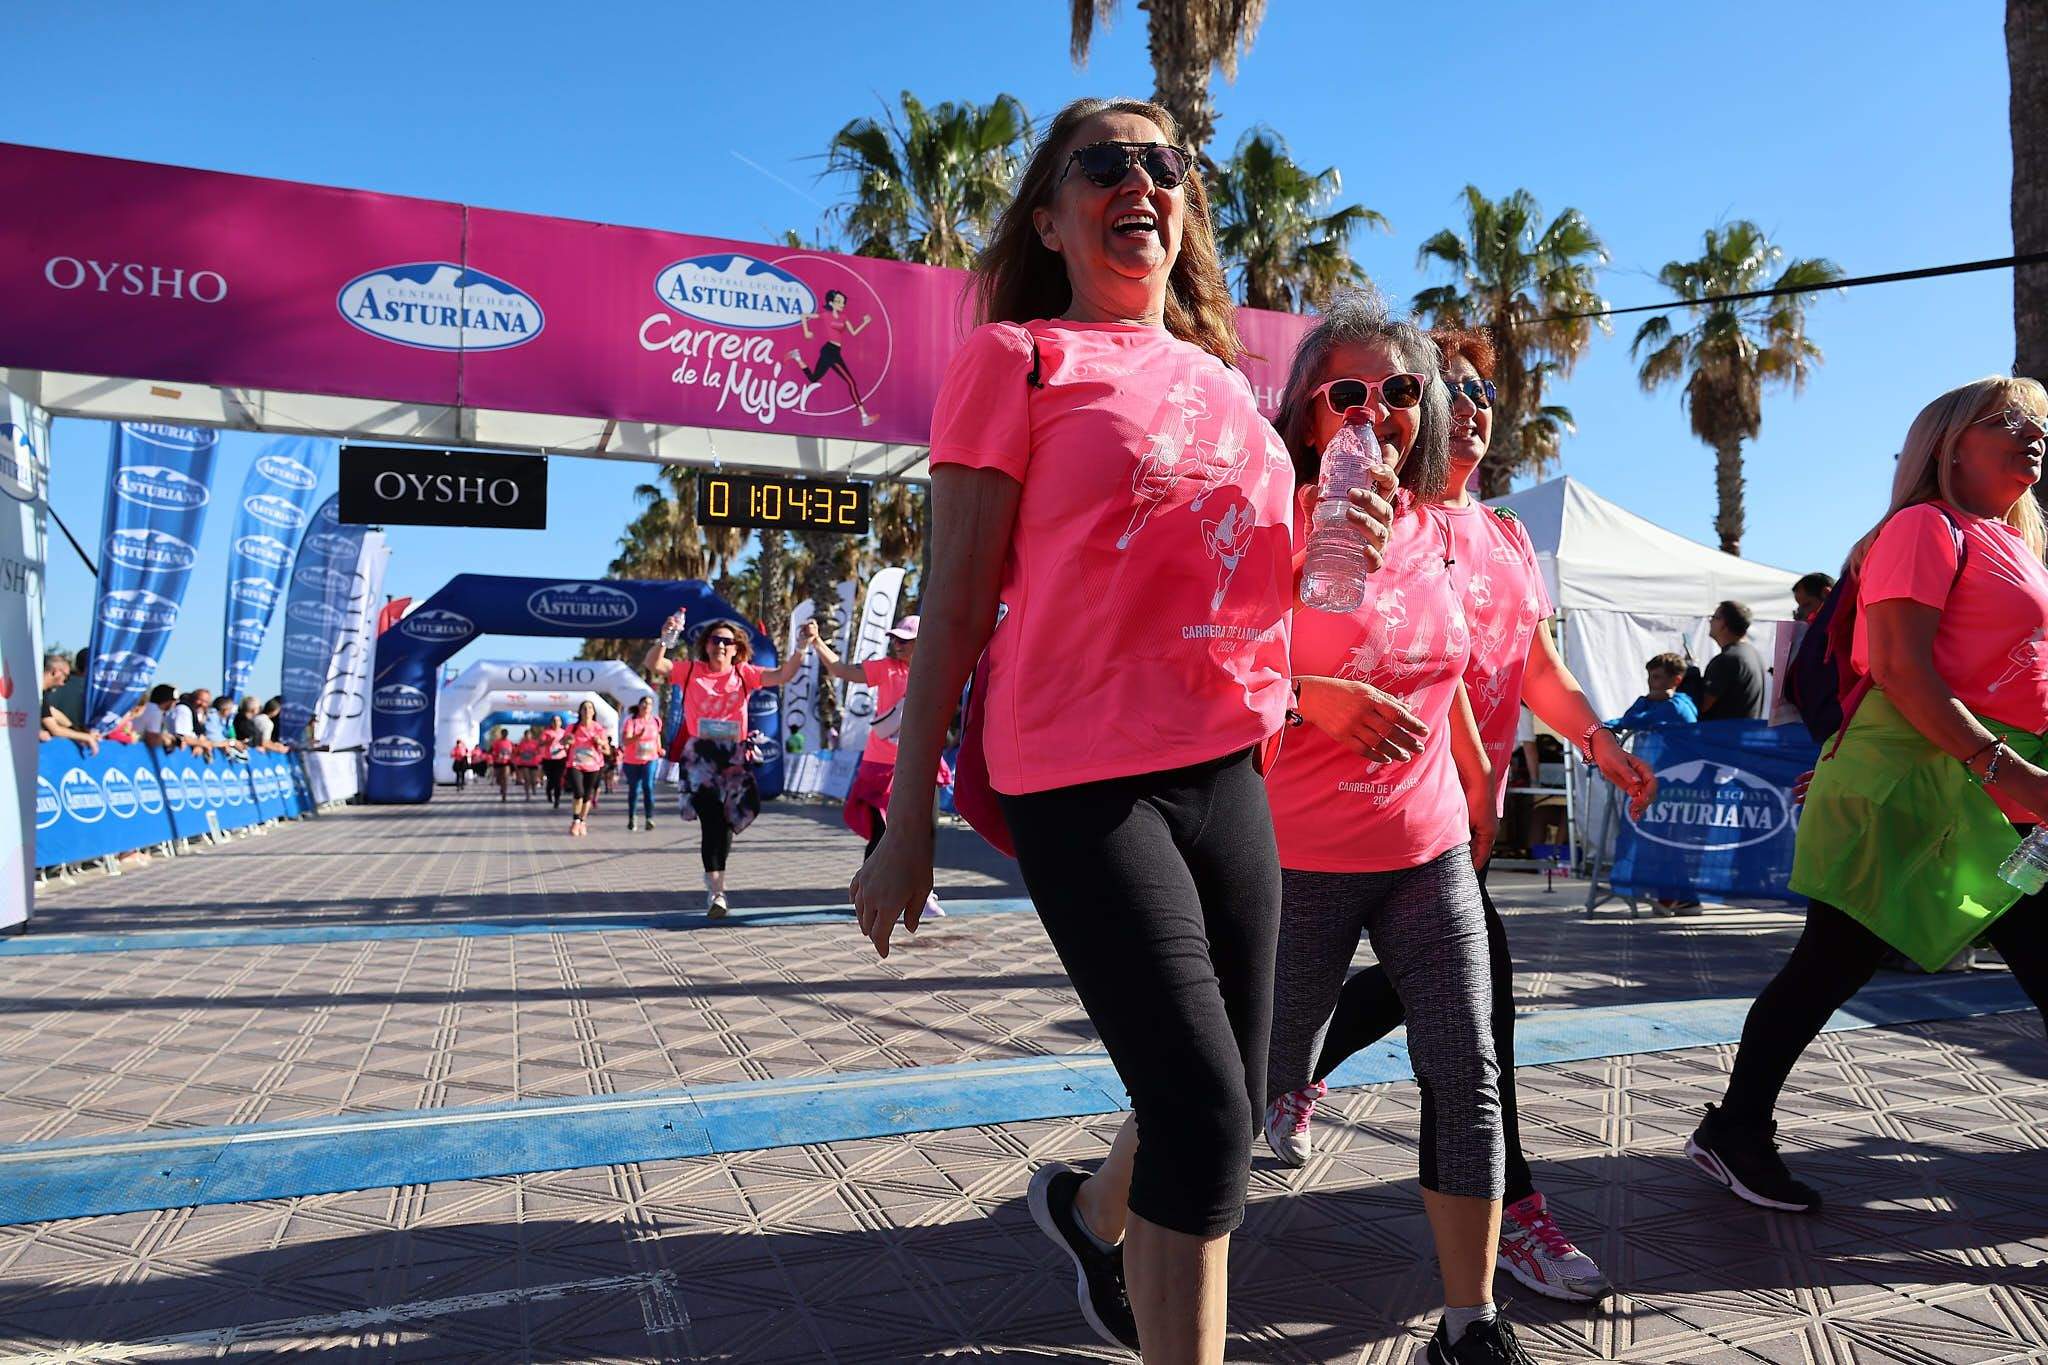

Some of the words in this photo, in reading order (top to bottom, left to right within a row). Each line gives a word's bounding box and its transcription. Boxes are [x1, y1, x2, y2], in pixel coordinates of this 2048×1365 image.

[44, 256, 228, 303] OYSHO
[693, 273, 744, 288] CENTRAL
[386, 286, 451, 302] CENTRAL
[668, 273, 804, 316] ASTURIANA
[354, 287, 529, 334] ASTURIANA
[638, 312, 774, 364] Carrera
[671, 357, 697, 386] de
[702, 360, 721, 388] la
[716, 361, 822, 425] Mujer
[374, 471, 520, 506] OYSHO
[709, 480, 730, 518] 0
[536, 594, 629, 617] ASTURIANA
[405, 620, 468, 636] ASTURIANA
[1182, 624, 1226, 640] CARRERA
[1216, 641, 1237, 653] 2024
[508, 666, 595, 684] OYSHO
[373, 746, 421, 759] ASTURIANA
[1338, 781, 1376, 794] CARRERA
[1377, 784, 1388, 794] DE
